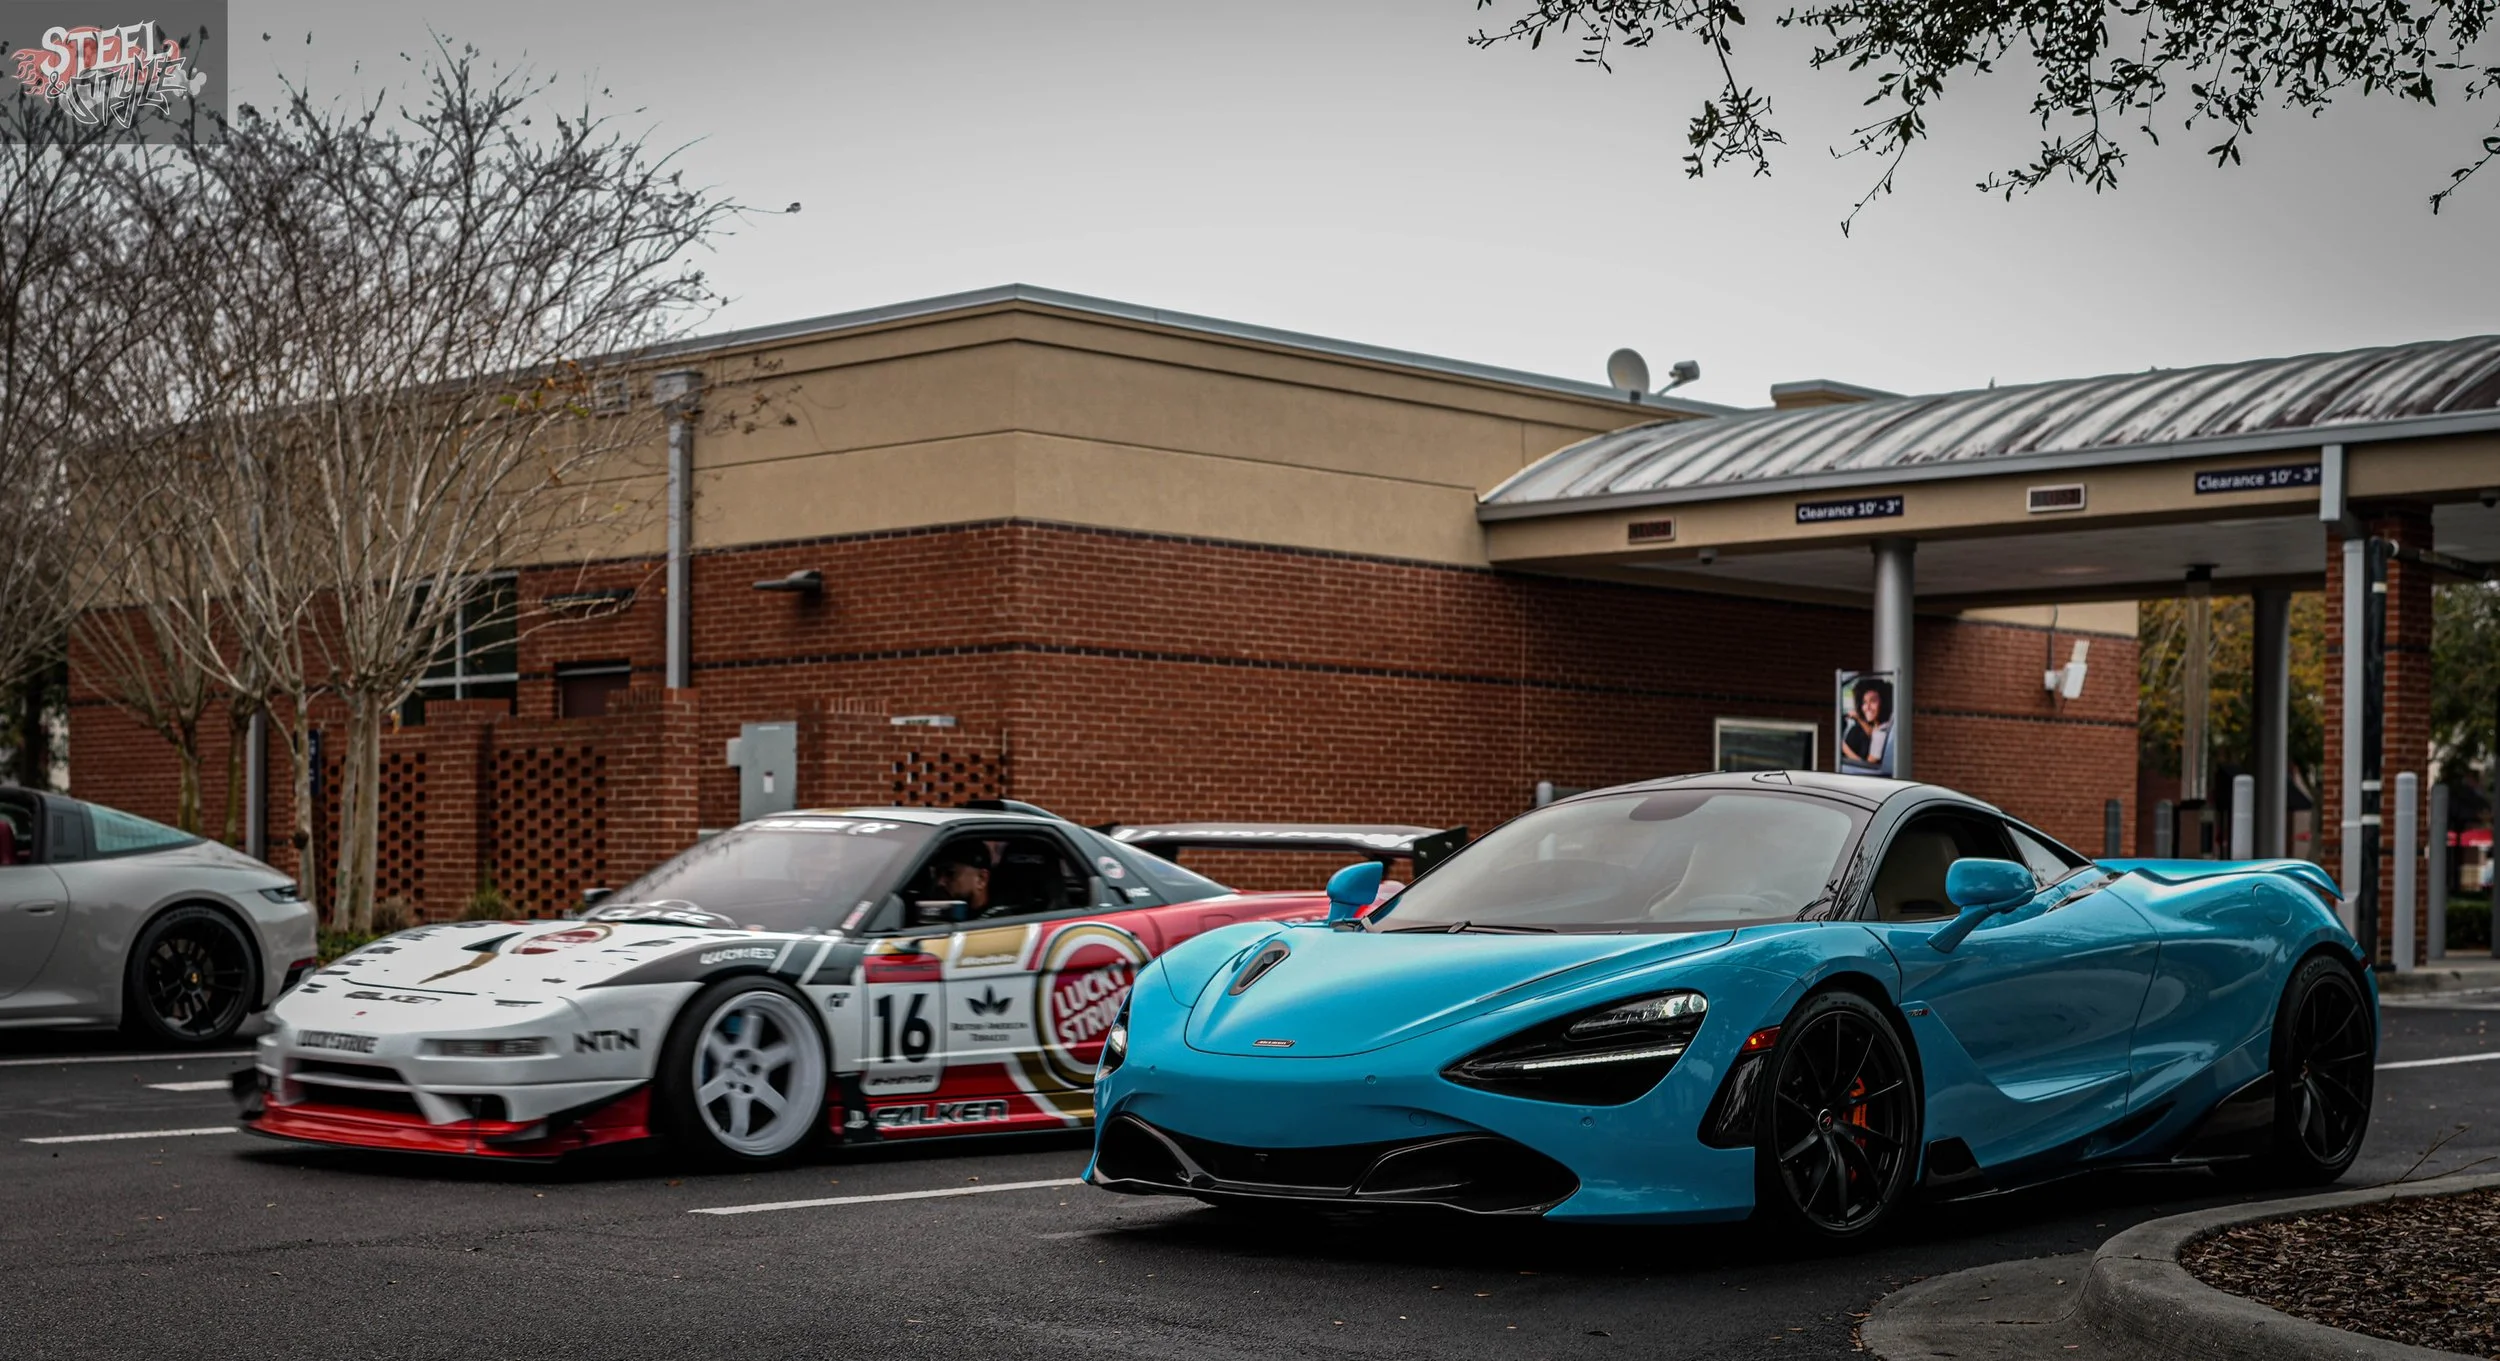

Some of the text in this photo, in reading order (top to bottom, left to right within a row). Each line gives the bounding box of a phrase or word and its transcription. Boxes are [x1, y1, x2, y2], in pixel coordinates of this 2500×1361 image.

[2197, 475, 2265, 490] Clearance
[1798, 505, 1855, 520] Clearance
[1054, 958, 1126, 1018] LUCKY
[572, 1028, 641, 1054] NTN
[874, 993, 935, 1063] 16
[870, 1100, 1009, 1129] FALKEN
